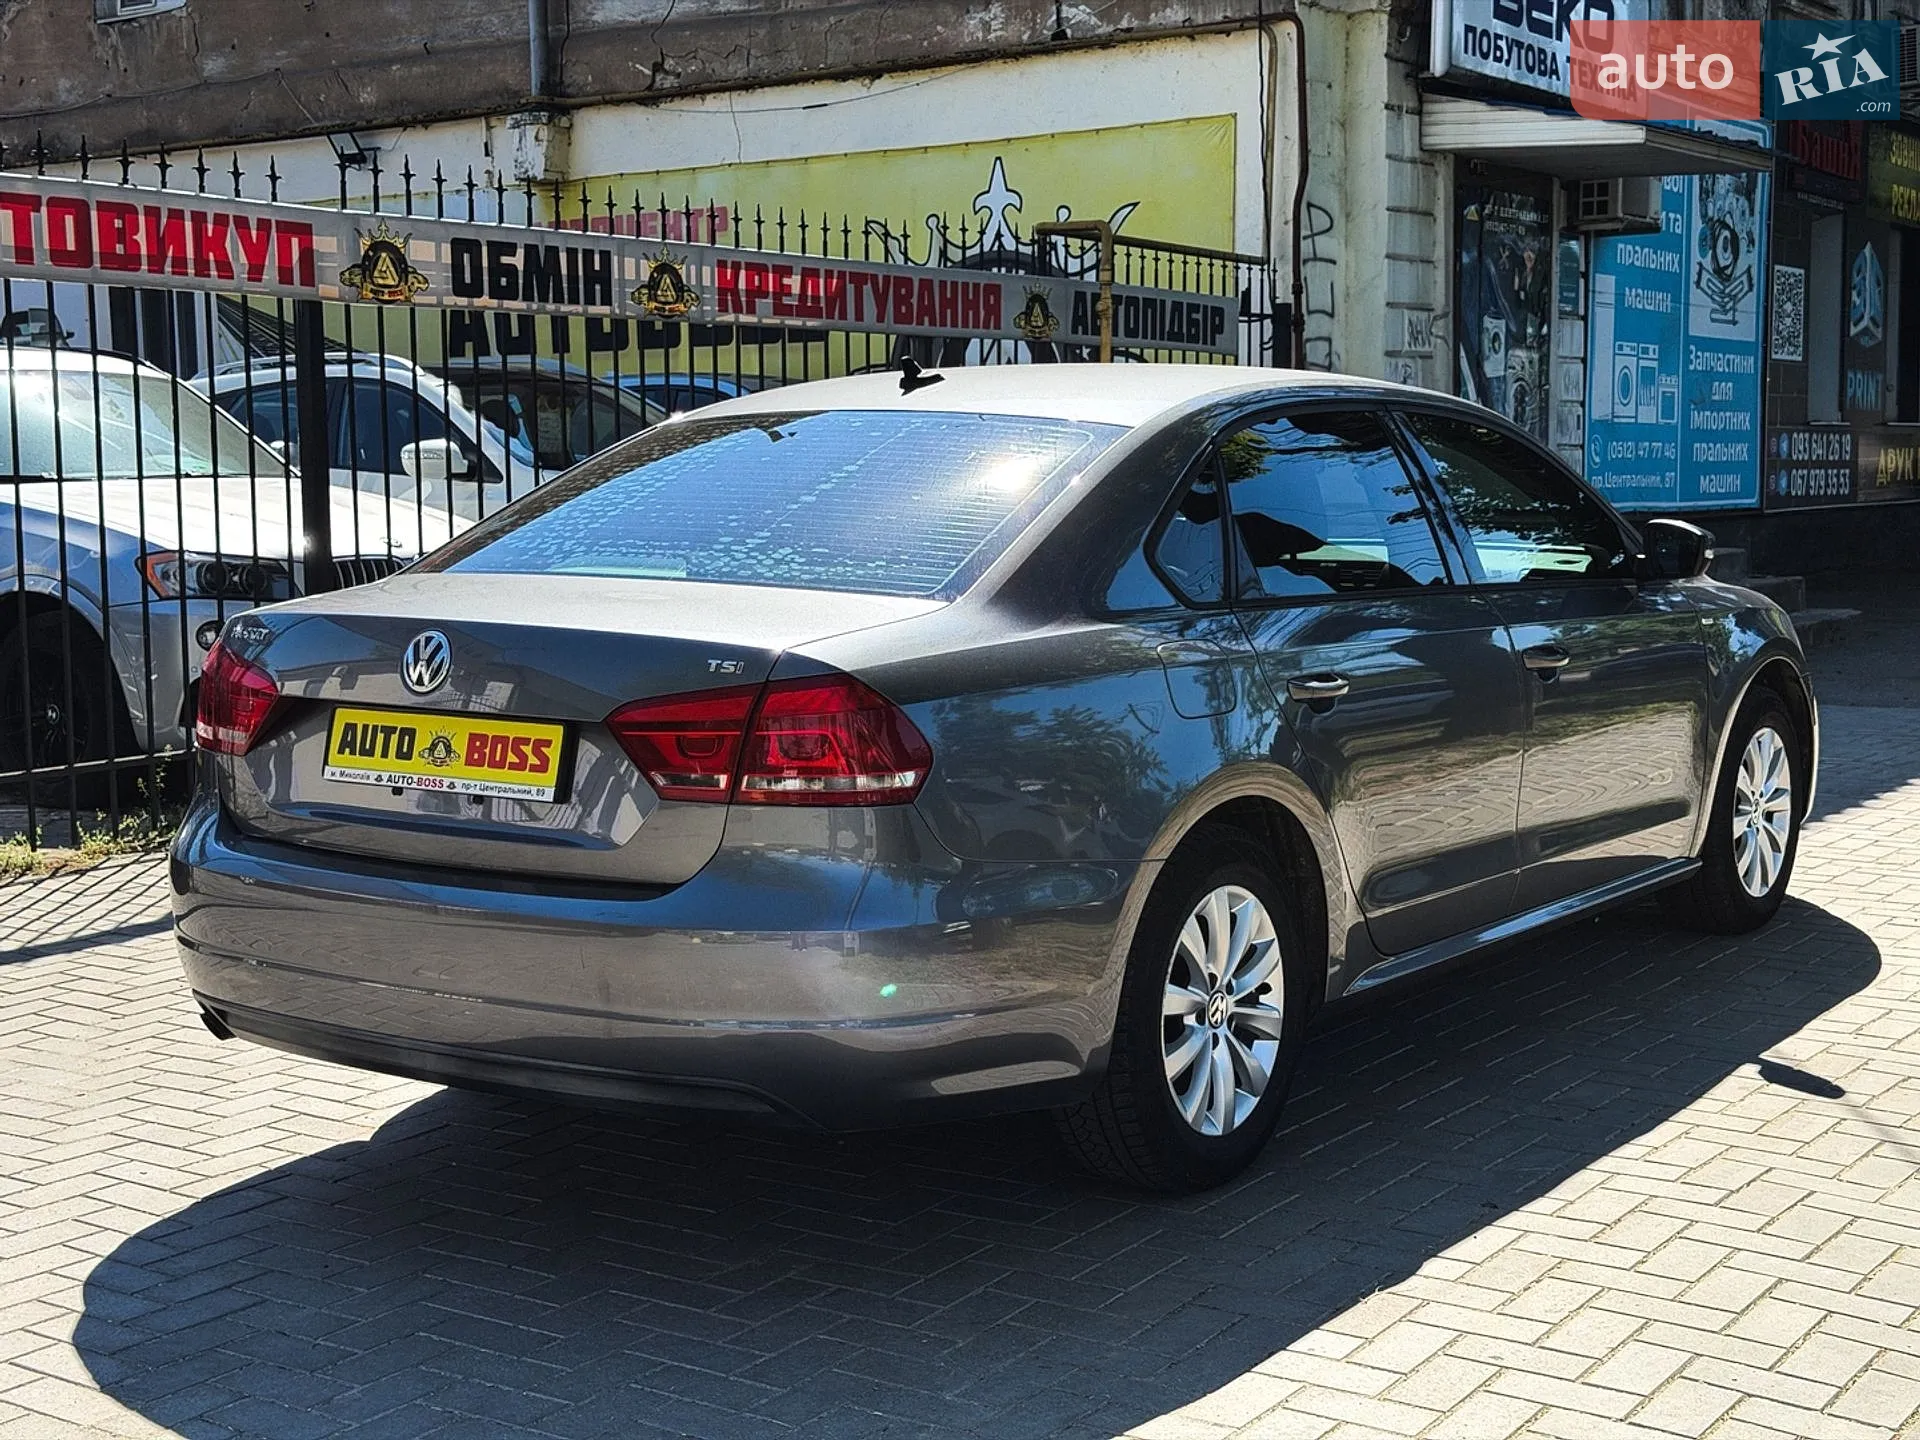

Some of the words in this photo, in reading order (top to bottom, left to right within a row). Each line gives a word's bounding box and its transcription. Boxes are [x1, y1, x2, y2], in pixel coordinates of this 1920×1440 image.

[1464, 24, 1560, 81] ПОБУТОВА
[1566, 56, 1637, 102] ТЕХА
[0, 192, 316, 288] ТОВИКУП
[450, 237, 613, 306] ОБМІН
[1617, 243, 1680, 273] пральних
[715, 258, 1002, 331] КРЕДИТУВАННЯ
[1624, 287, 1671, 313] машин
[1688, 344, 1754, 374] Запчастини
[1711, 381, 1734, 401] для
[1846, 369, 1884, 411] PRINT
[1693, 442, 1749, 463] пральних
[1791, 432, 1809, 461] 093
[1841, 433, 1851, 461] 19
[1876, 447, 1914, 487] ДРУК
[1700, 474, 1741, 494] машин
[1790, 469, 1808, 496] 067
[1809, 469, 1826, 496] 979
[1826, 469, 1838, 496] 35
[1839, 469, 1850, 496] 53
[337, 722, 416, 761] AUTO
[464, 733, 553, 774] BOSS
[386, 774, 445, 789] AUTO-BOSS
